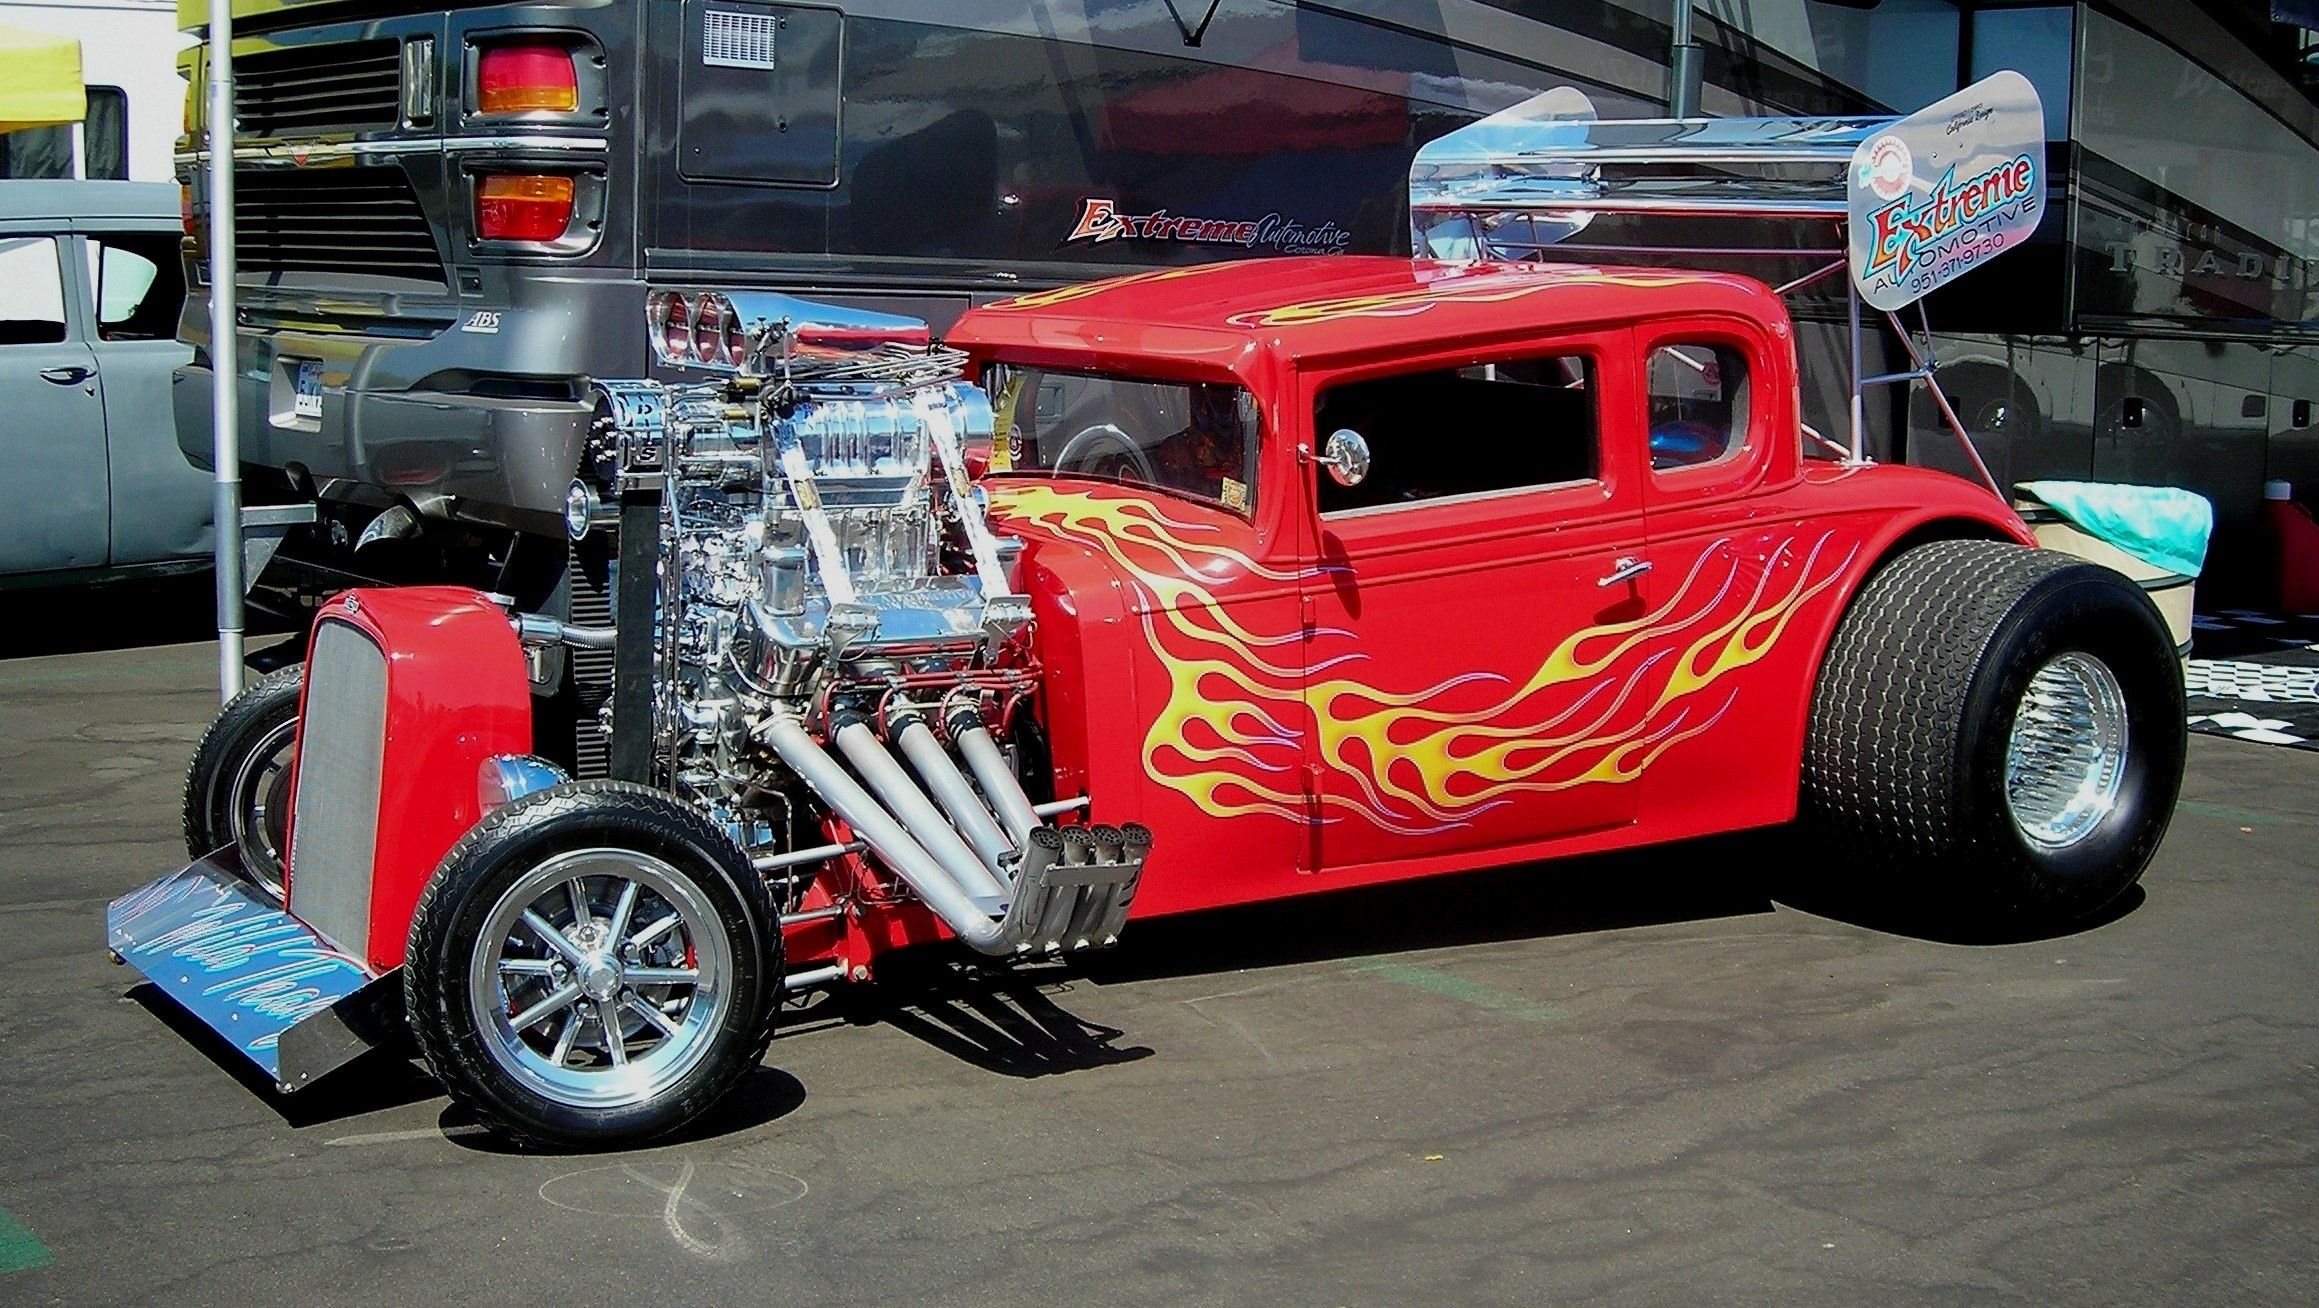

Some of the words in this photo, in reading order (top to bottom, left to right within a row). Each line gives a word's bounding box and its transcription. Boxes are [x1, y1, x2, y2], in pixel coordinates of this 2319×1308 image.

[1067, 198, 1258, 243] Extreme
[1246, 212, 1351, 250] Automotive
[1863, 154, 2035, 288] Extreme
[1873, 196, 2036, 295] AUOMOTIVE
[1911, 233, 2005, 294] 951-371-9730
[2106, 241, 2317, 281] TRADI
[463, 311, 502, 328] ABS
